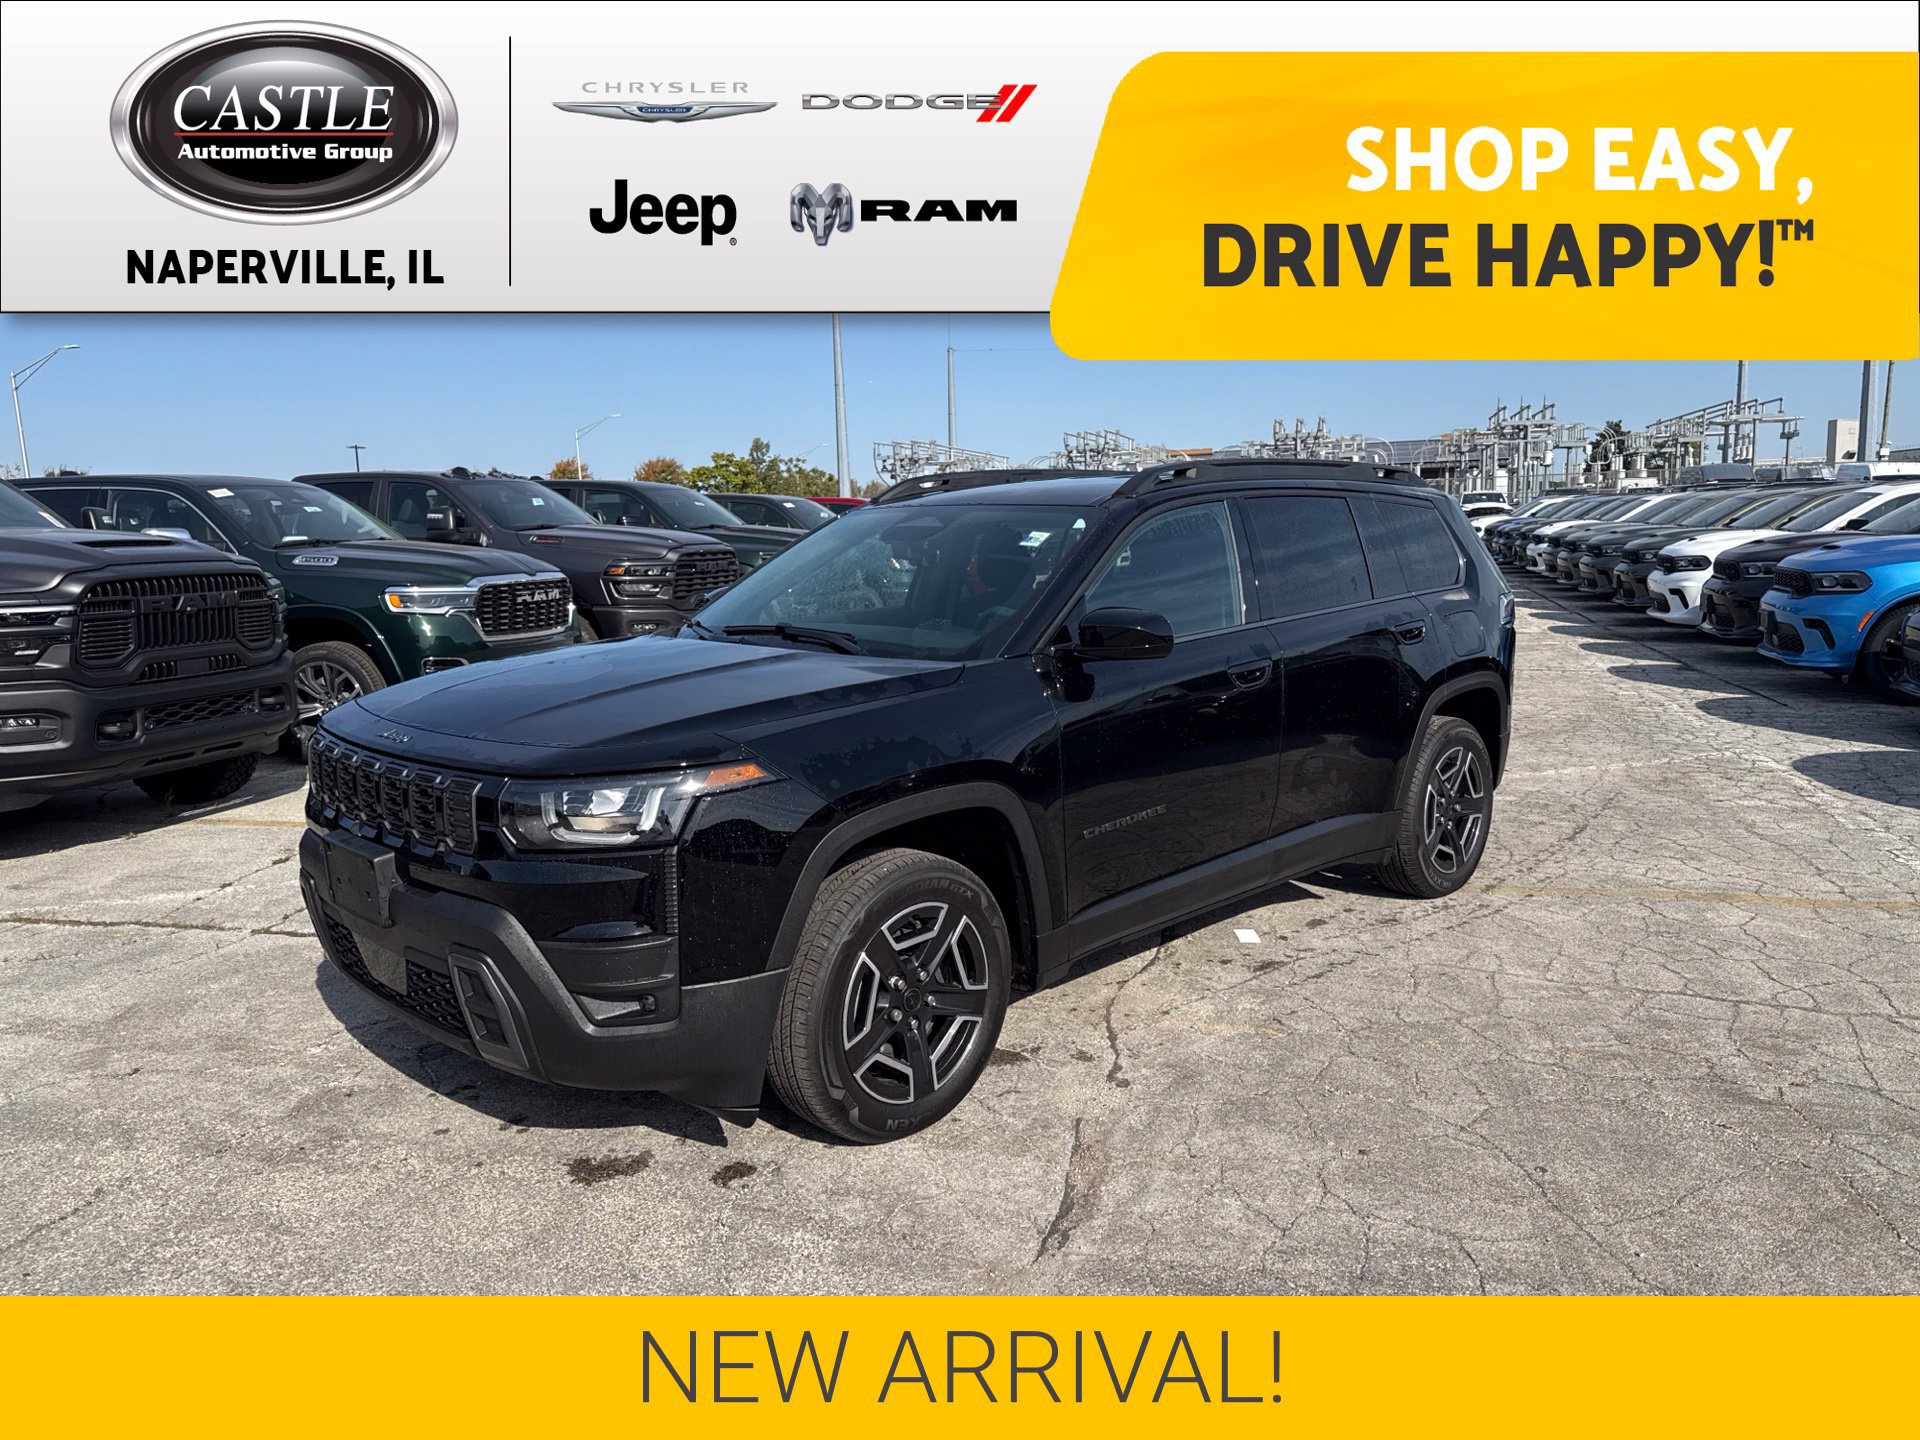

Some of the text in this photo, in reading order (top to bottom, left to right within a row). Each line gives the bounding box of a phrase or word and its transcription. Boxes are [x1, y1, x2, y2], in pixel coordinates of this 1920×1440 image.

[696, 560, 729, 572] RAM
[140, 592, 236, 614] RAM
[515, 588, 560, 603] RAM
[1082, 803, 1168, 840] CHEROKEE
